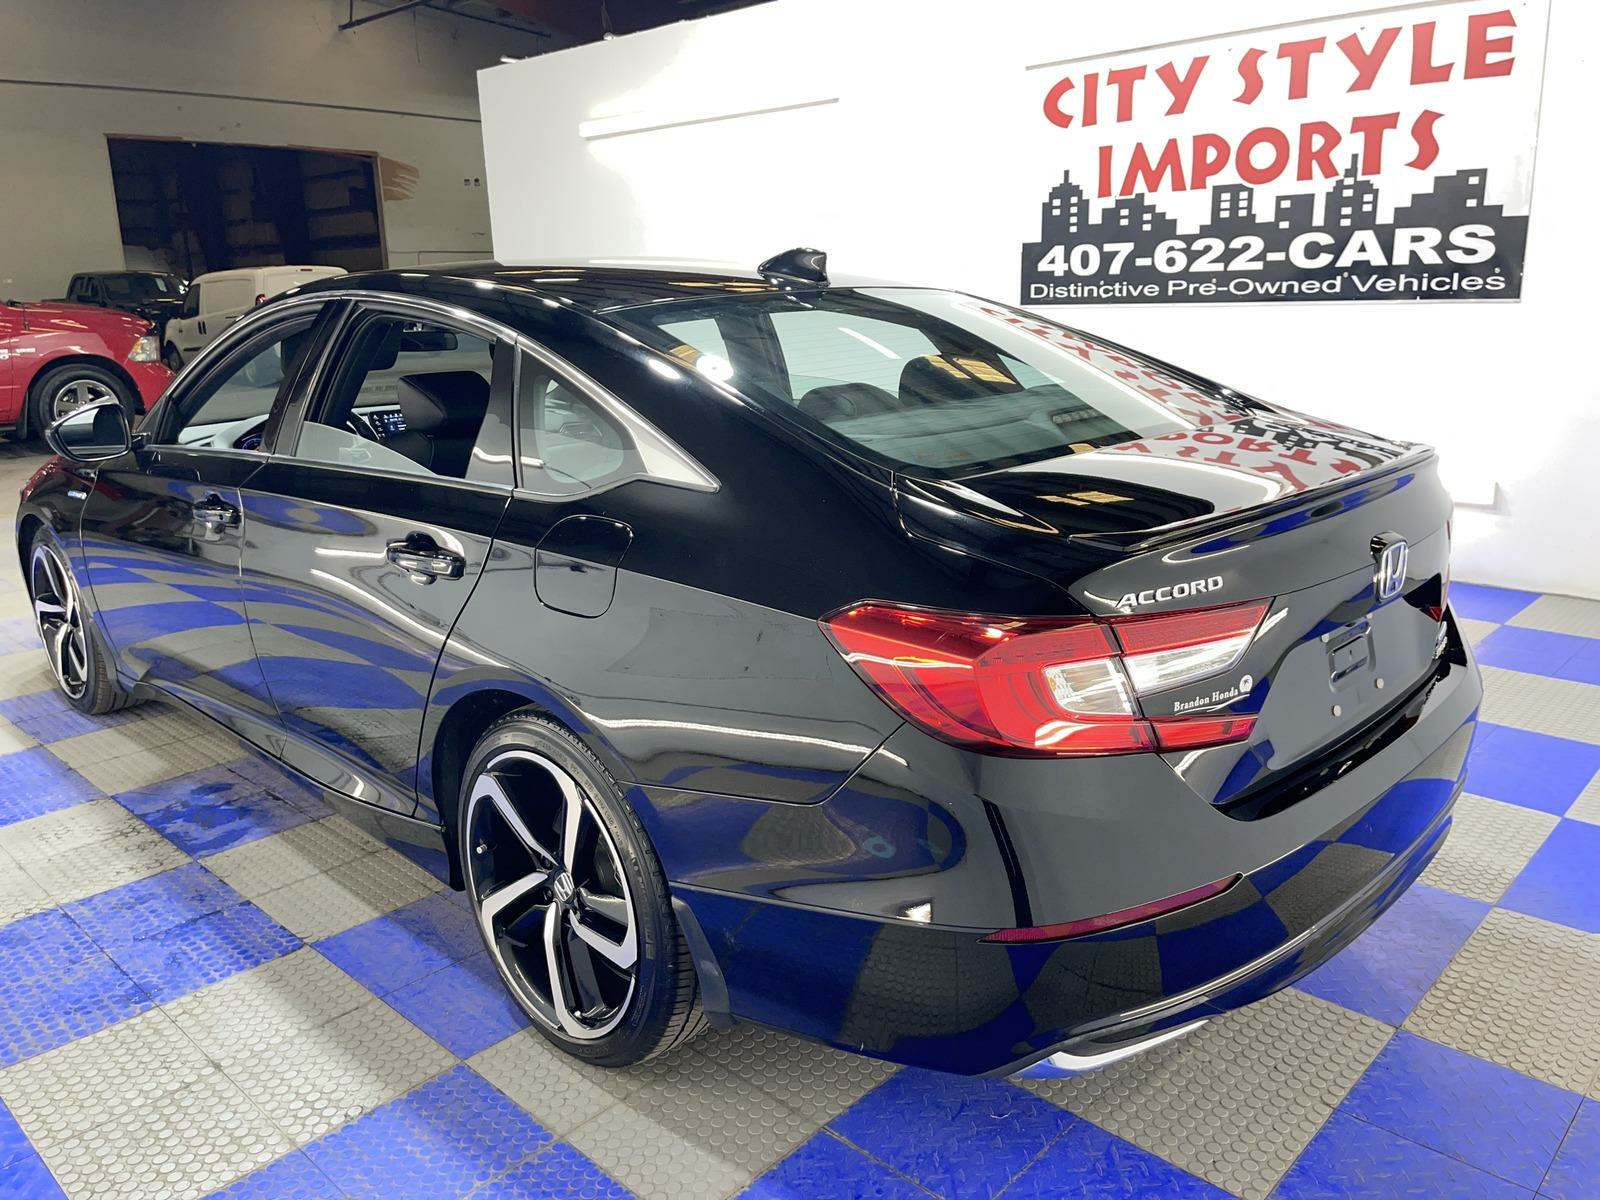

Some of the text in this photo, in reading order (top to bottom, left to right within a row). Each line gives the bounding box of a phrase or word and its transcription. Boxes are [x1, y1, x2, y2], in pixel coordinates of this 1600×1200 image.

[1043, 9, 1518, 129] CITY STYLE
[1097, 109, 1446, 198] IMPORTS
[1036, 223, 1497, 277] 407-622-CARS
[1029, 271, 1507, 299] Distinctive Pre-Owned Vehicles
[1115, 575, 1224, 608] ACCORD
[1173, 686, 1239, 712] Brandon Honda
